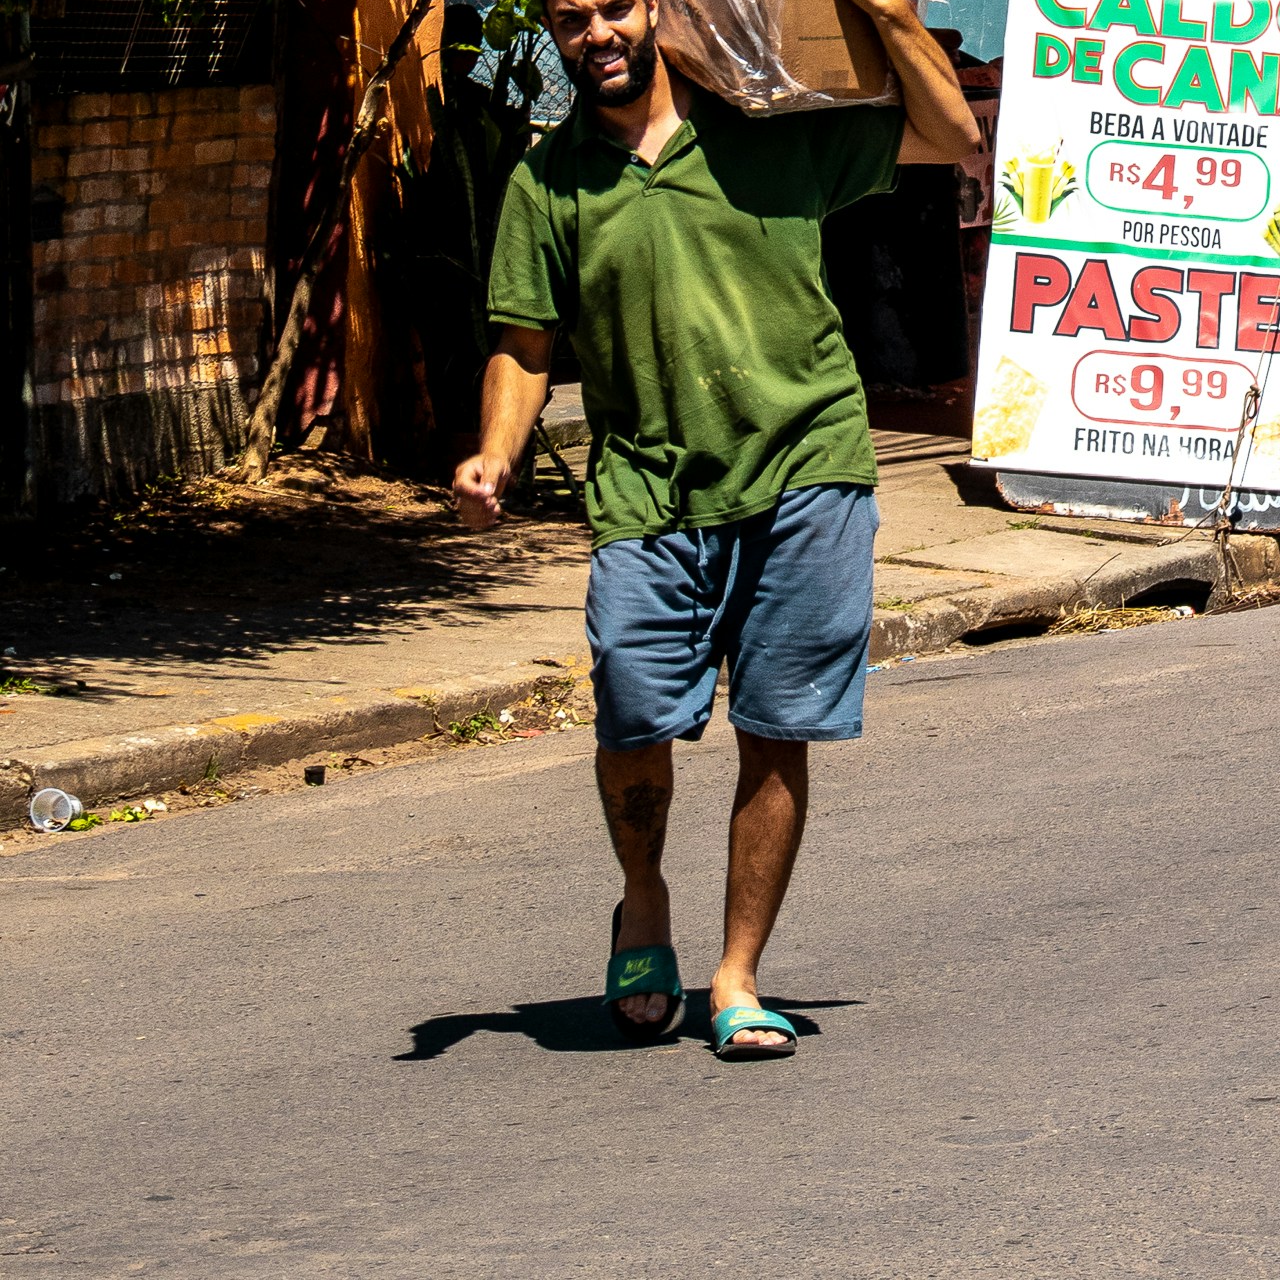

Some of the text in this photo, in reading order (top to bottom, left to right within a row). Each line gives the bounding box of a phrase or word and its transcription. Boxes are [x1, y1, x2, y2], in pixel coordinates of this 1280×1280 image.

[1032, 32, 1105, 86] DE
[1090, 111, 1269, 149] BEBA A VONTADE
[1122, 220, 1222, 250] POR PESSOA
[1073, 427, 1236, 462] FRITO NA HORA
